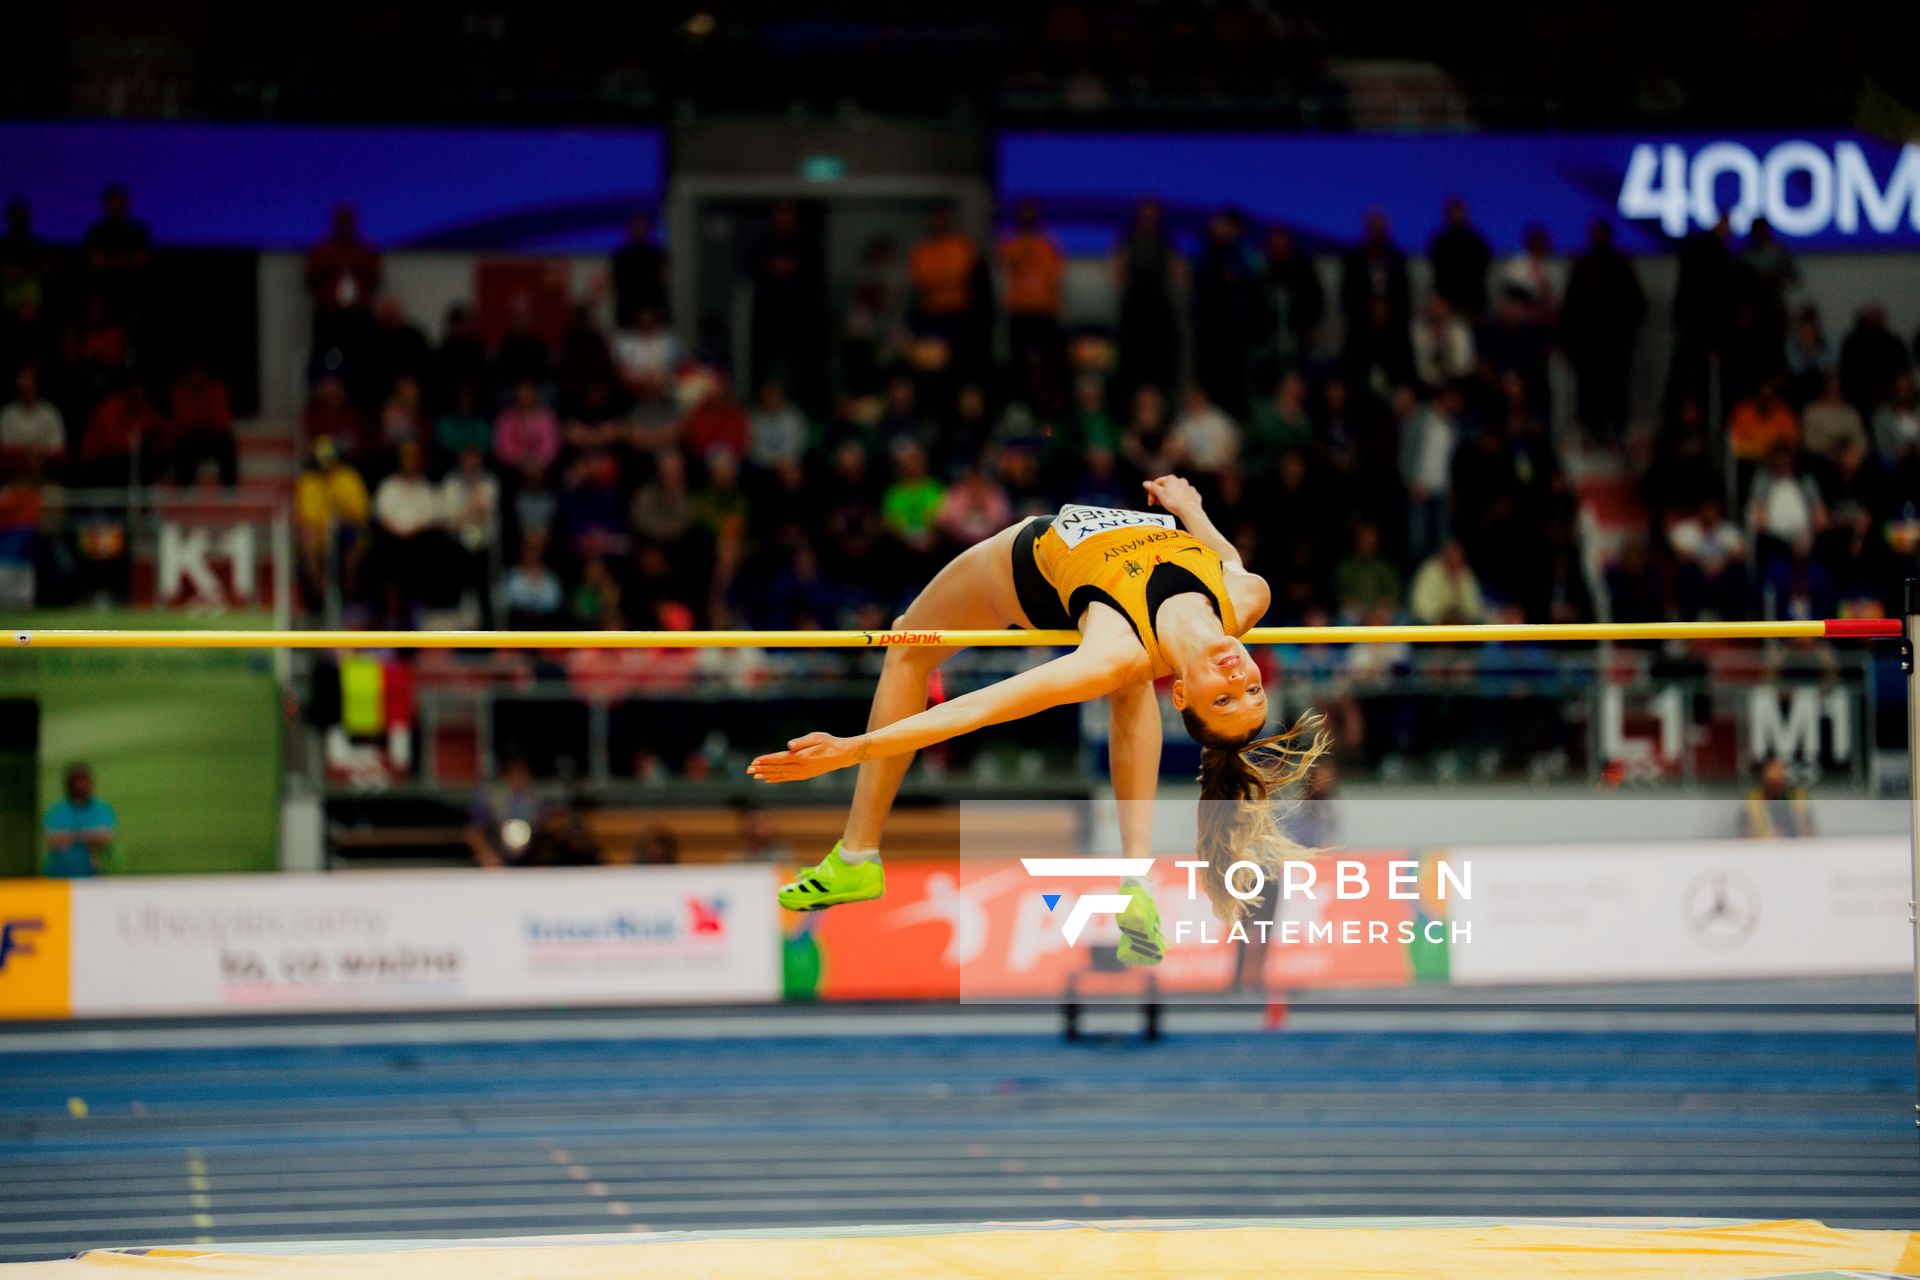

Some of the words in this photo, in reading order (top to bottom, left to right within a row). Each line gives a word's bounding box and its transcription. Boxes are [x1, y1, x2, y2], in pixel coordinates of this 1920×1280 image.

[159, 521, 253, 603] K1
[1104, 529, 1180, 562] ERMANY
[879, 632, 942, 645] polanik
[1603, 683, 1683, 763] L1
[1751, 683, 1851, 763] M1
